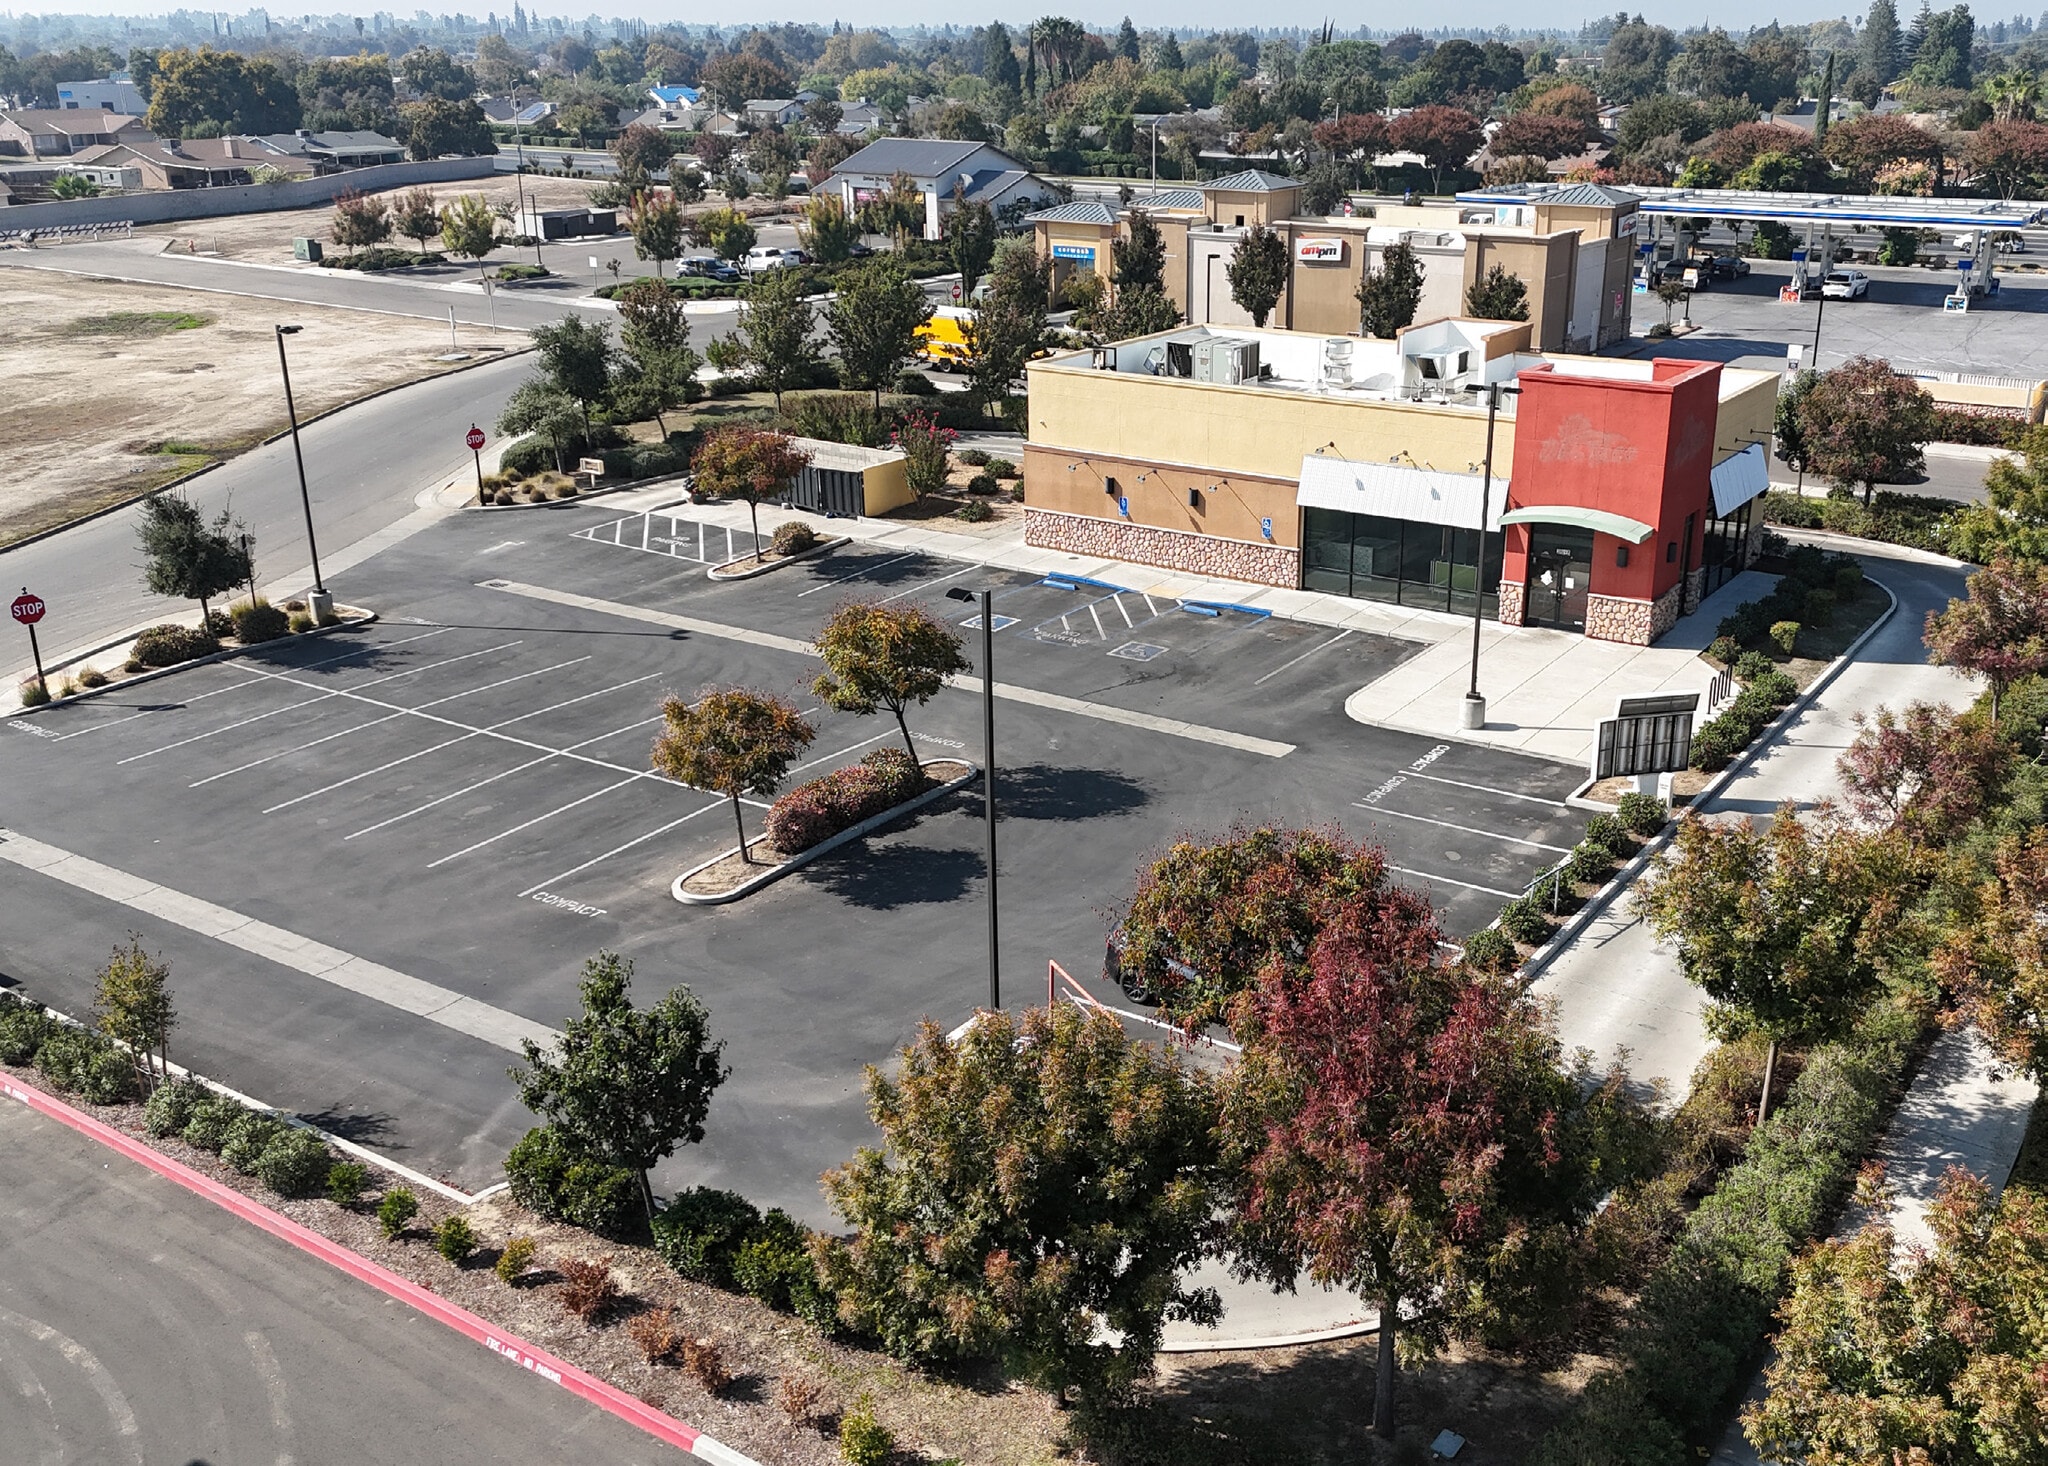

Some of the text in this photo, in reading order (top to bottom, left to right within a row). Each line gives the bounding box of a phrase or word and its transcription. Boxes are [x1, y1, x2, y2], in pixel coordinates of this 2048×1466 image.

[1301, 246, 1337, 259] ampm
[467, 434, 484, 445] STOP
[13, 602, 43, 617] STOP
[1408, 744, 1451, 772] COMPACT
[1362, 775, 1407, 804] COMPACT
[532, 891, 608, 918] COMPACT
[486, 1336, 561, 1383] FIRE LANE NO PARKING
